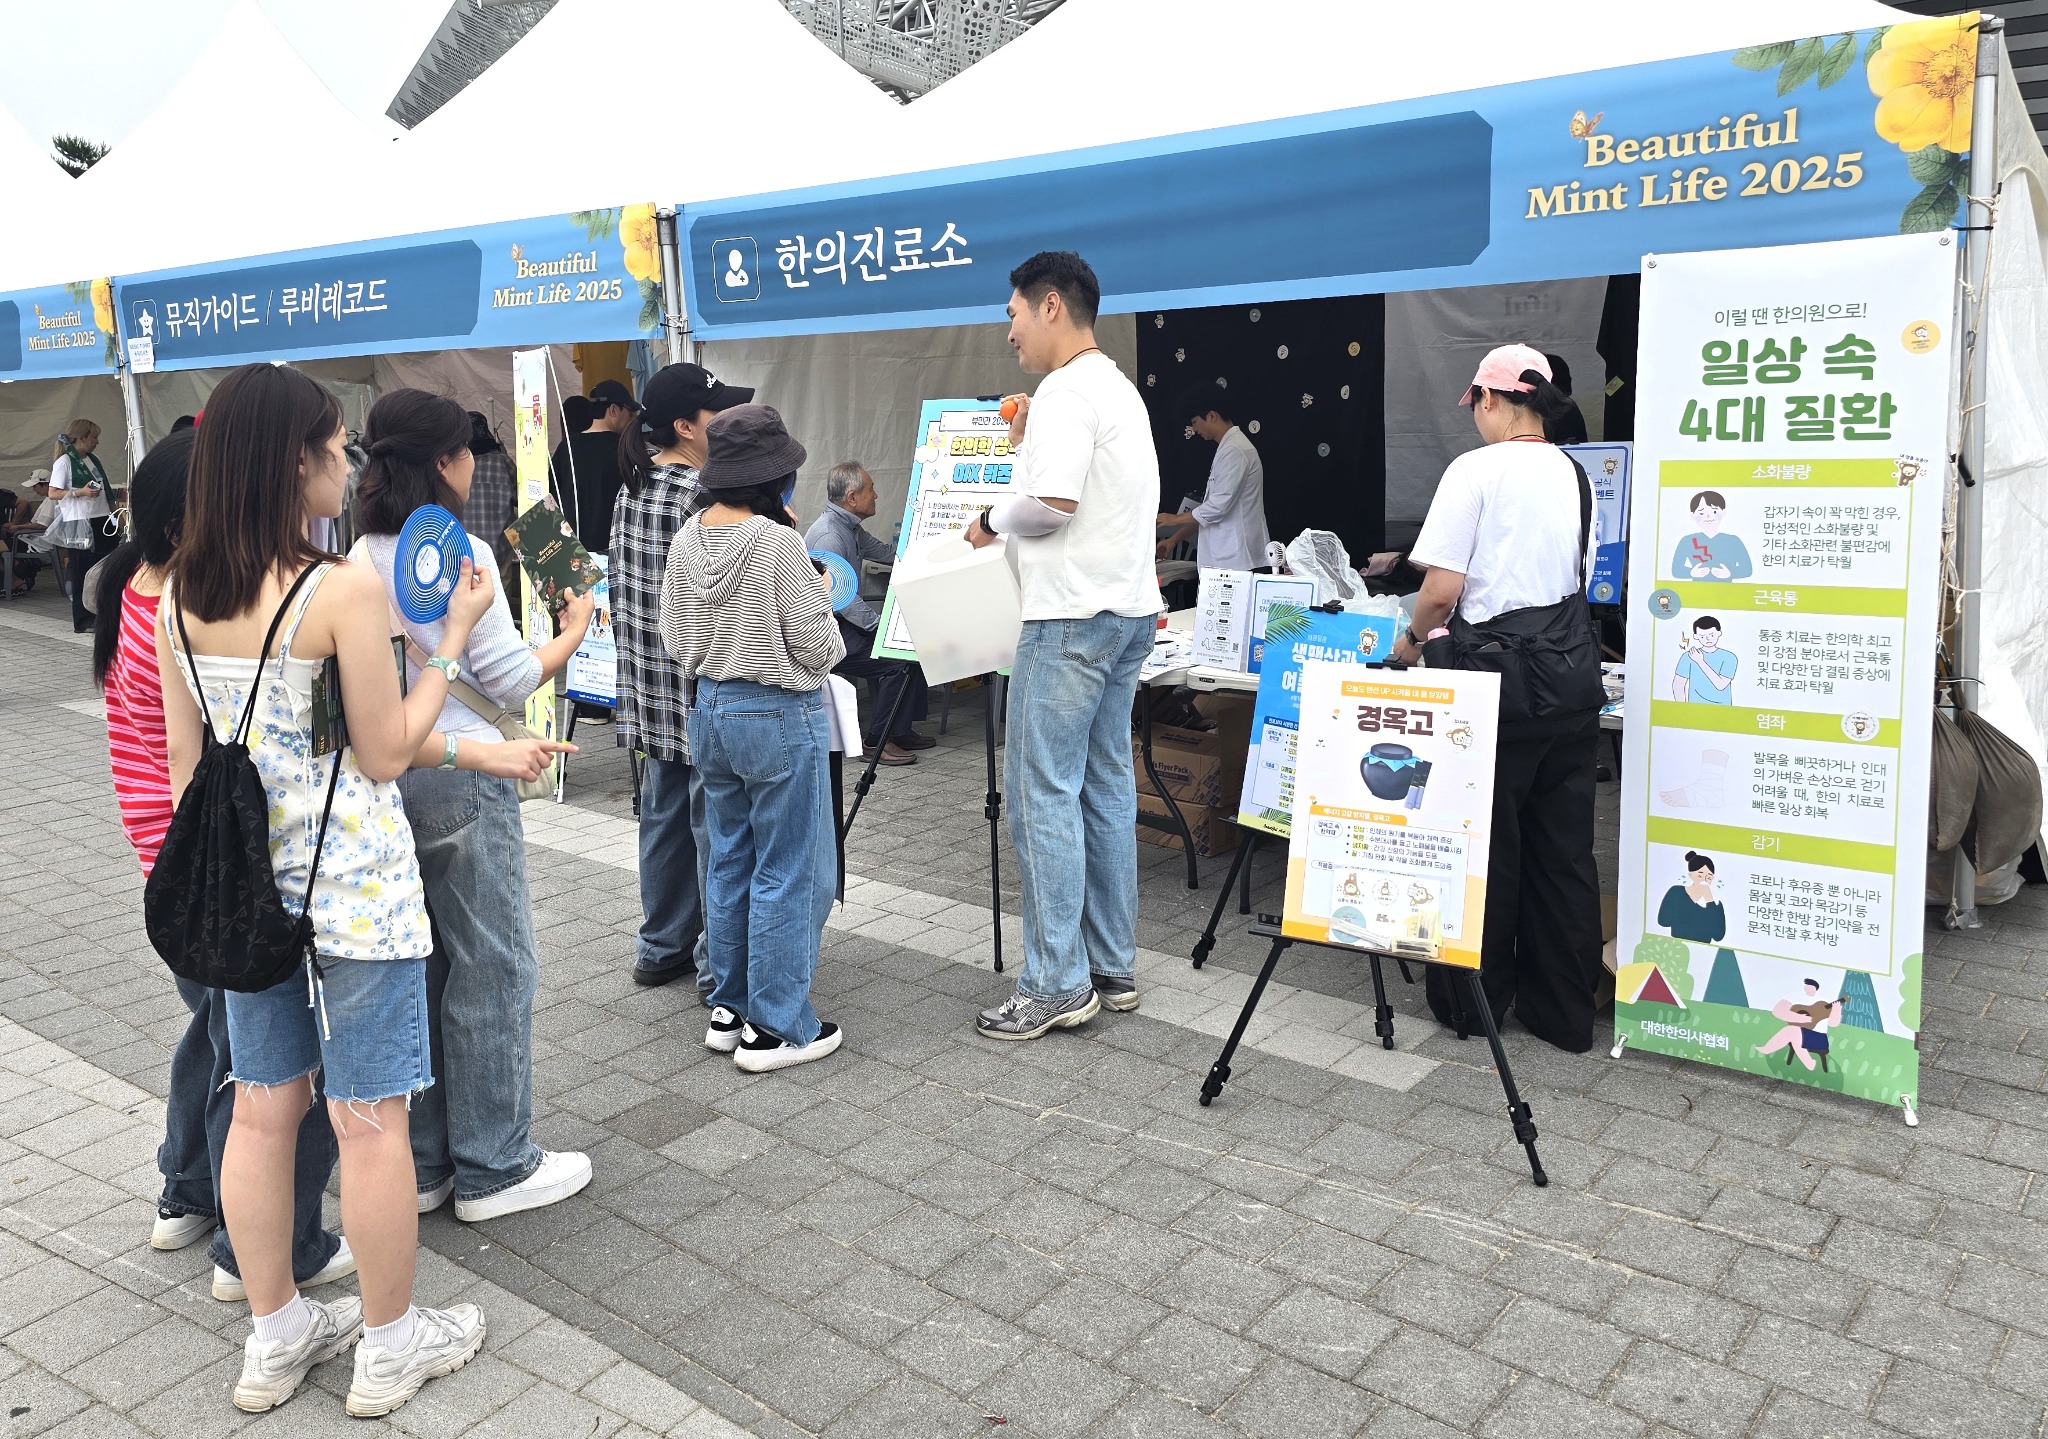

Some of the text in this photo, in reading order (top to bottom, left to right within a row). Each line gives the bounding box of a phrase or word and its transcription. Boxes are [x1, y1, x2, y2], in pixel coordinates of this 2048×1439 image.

[1584, 108, 1799, 167] Beautiful
[1525, 152, 1863, 219] Mint Life 2025
[516, 251, 597, 279] Beautiful
[776, 223, 973, 288] 한의진료소
[492, 279, 622, 308] Mint Life 2025
[166, 292, 259, 338] 뮤직가이드
[279, 280, 387, 326] 루비레코드
[1715, 302, 1867, 327] 이럴 땐 한의원으로!
[39, 310, 82, 330] Beautiful
[29, 331, 96, 351] Mint Life 2025
[1702, 334, 1877, 386] 일상 속
[992, 416, 1009, 426] 202
[1678, 392, 1897, 442] 4대 질환
[950, 436, 994, 456] 한의학
[983, 464, 1014, 484] 퀴즈
[1752, 464, 1811, 481] 소화불량
[1596, 489, 1615, 497] 벤트
[1764, 506, 1901, 520] 갑자기 속이 꽉 막힌 경우,
[1764, 522, 1879, 536] 만성적인 소화불량 및
[1763, 538, 1891, 553] 기타 소화관련 불편감에
[1762, 554, 1851, 569] 한의 치료가 탁월
[1754, 590, 1798, 607] 근육통
[1758, 630, 1892, 648] 통증 치료는 한의학 최고
[1758, 646, 1892, 666] 의 강점 분야로서 근육통
[1758, 662, 1890, 682] 및 다양한 담 결림 증상에
[1757, 678, 1834, 695] 치료 효과 탁월
[1357, 705, 1434, 736] 경옥고
[1756, 713, 1786, 731] 염좌
[1754, 752, 1886, 777] 발목을 삐끗하거나 인대
[1754, 768, 1885, 794] 의 가벼운 손상으로 걷기
[1753, 784, 1885, 809] 어려울 때, 한의 치료로
[1752, 800, 1829, 820] 빠른 일상 회복
[1751, 834, 1780, 852] 감기
[1748, 874, 1881, 904] 코로나 후유증 뿐 아니라
[1748, 889, 1868, 918] 몸살 및 코와 목감기 등
[1748, 906, 1880, 937] 다양한 한방 감기약을 전
[1748, 920, 1839, 947] 문적 진찰 후 처방
[1640, 1020, 1729, 1051] 대한한의사협회
